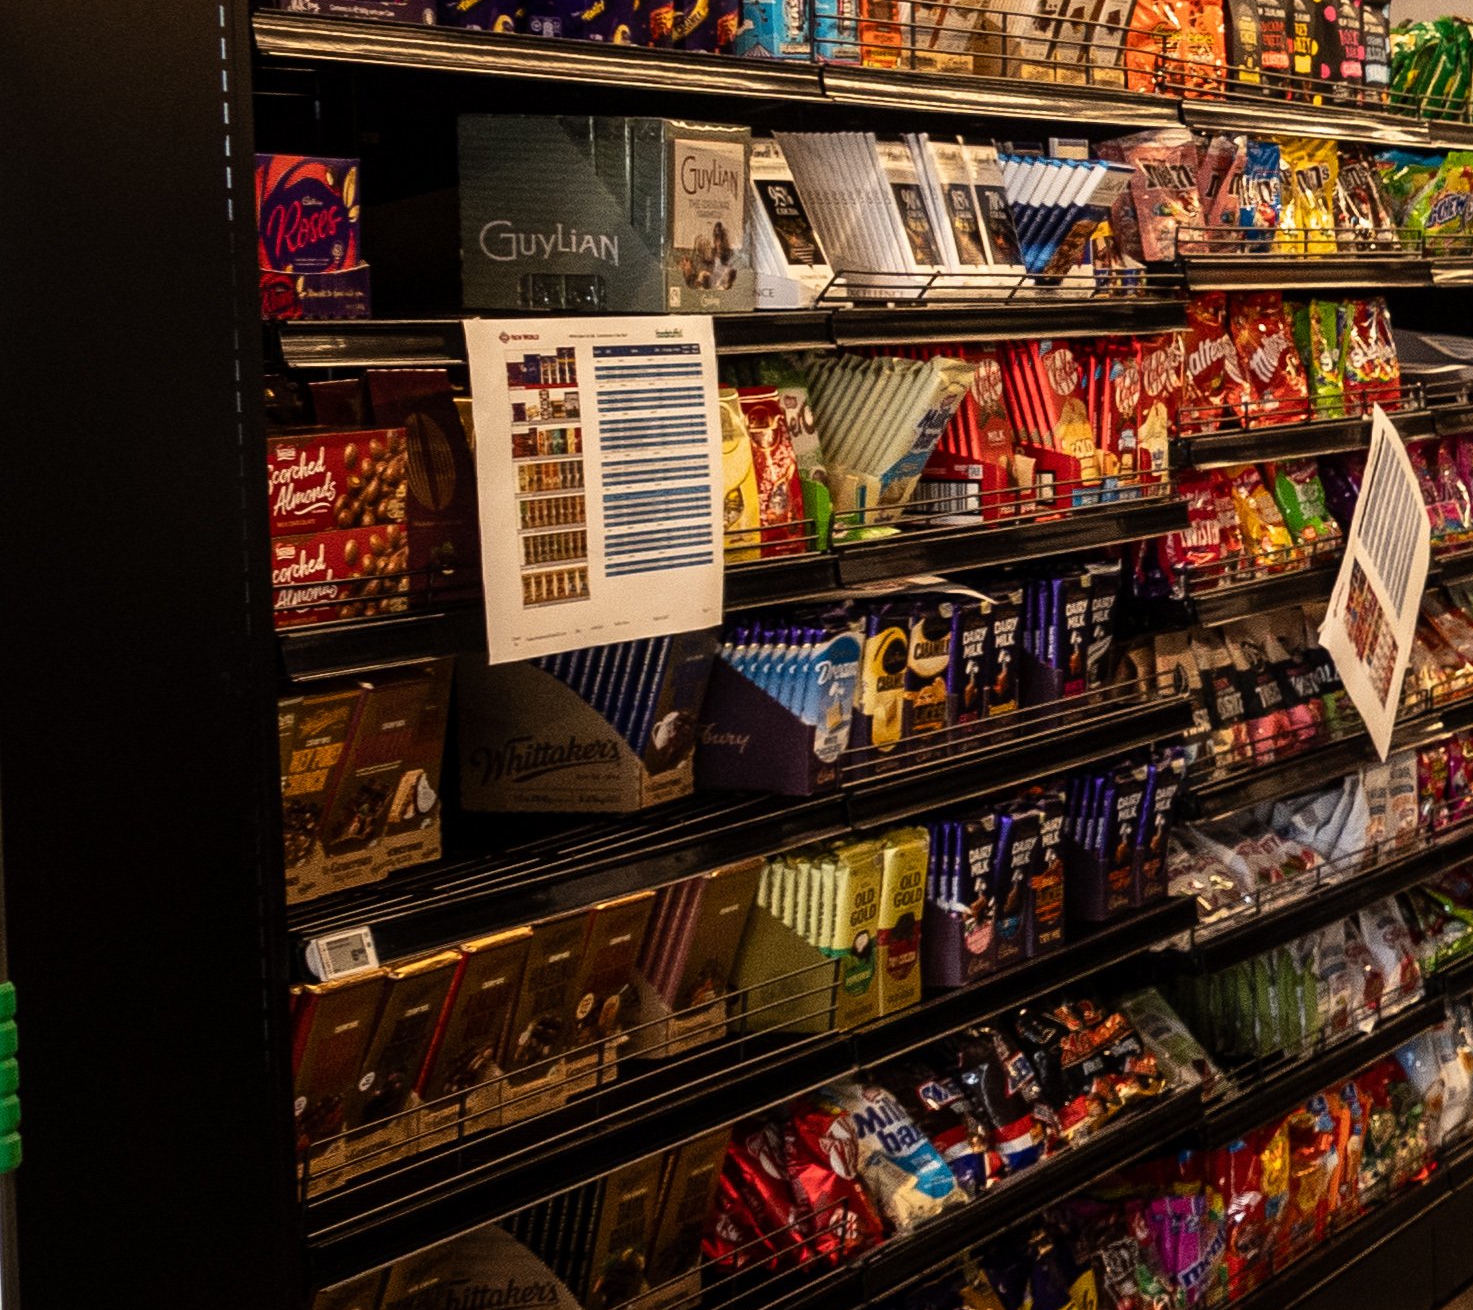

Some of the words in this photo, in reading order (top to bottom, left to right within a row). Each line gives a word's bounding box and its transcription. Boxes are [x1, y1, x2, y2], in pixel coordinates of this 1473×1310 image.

[266, 204, 342, 259] Roses
[273, 472, 336, 517] Almonds
[272, 544, 326, 584] corched
[994, 617, 1019, 634] DAIRY
[995, 632, 1016, 649] MILK
[469, 735, 622, 787] Whittaker's
[901, 871, 921, 889] OLD
[855, 889, 875, 907] OLD
[893, 887, 922, 908] GOLD
[850, 903, 876, 927] GOLD
